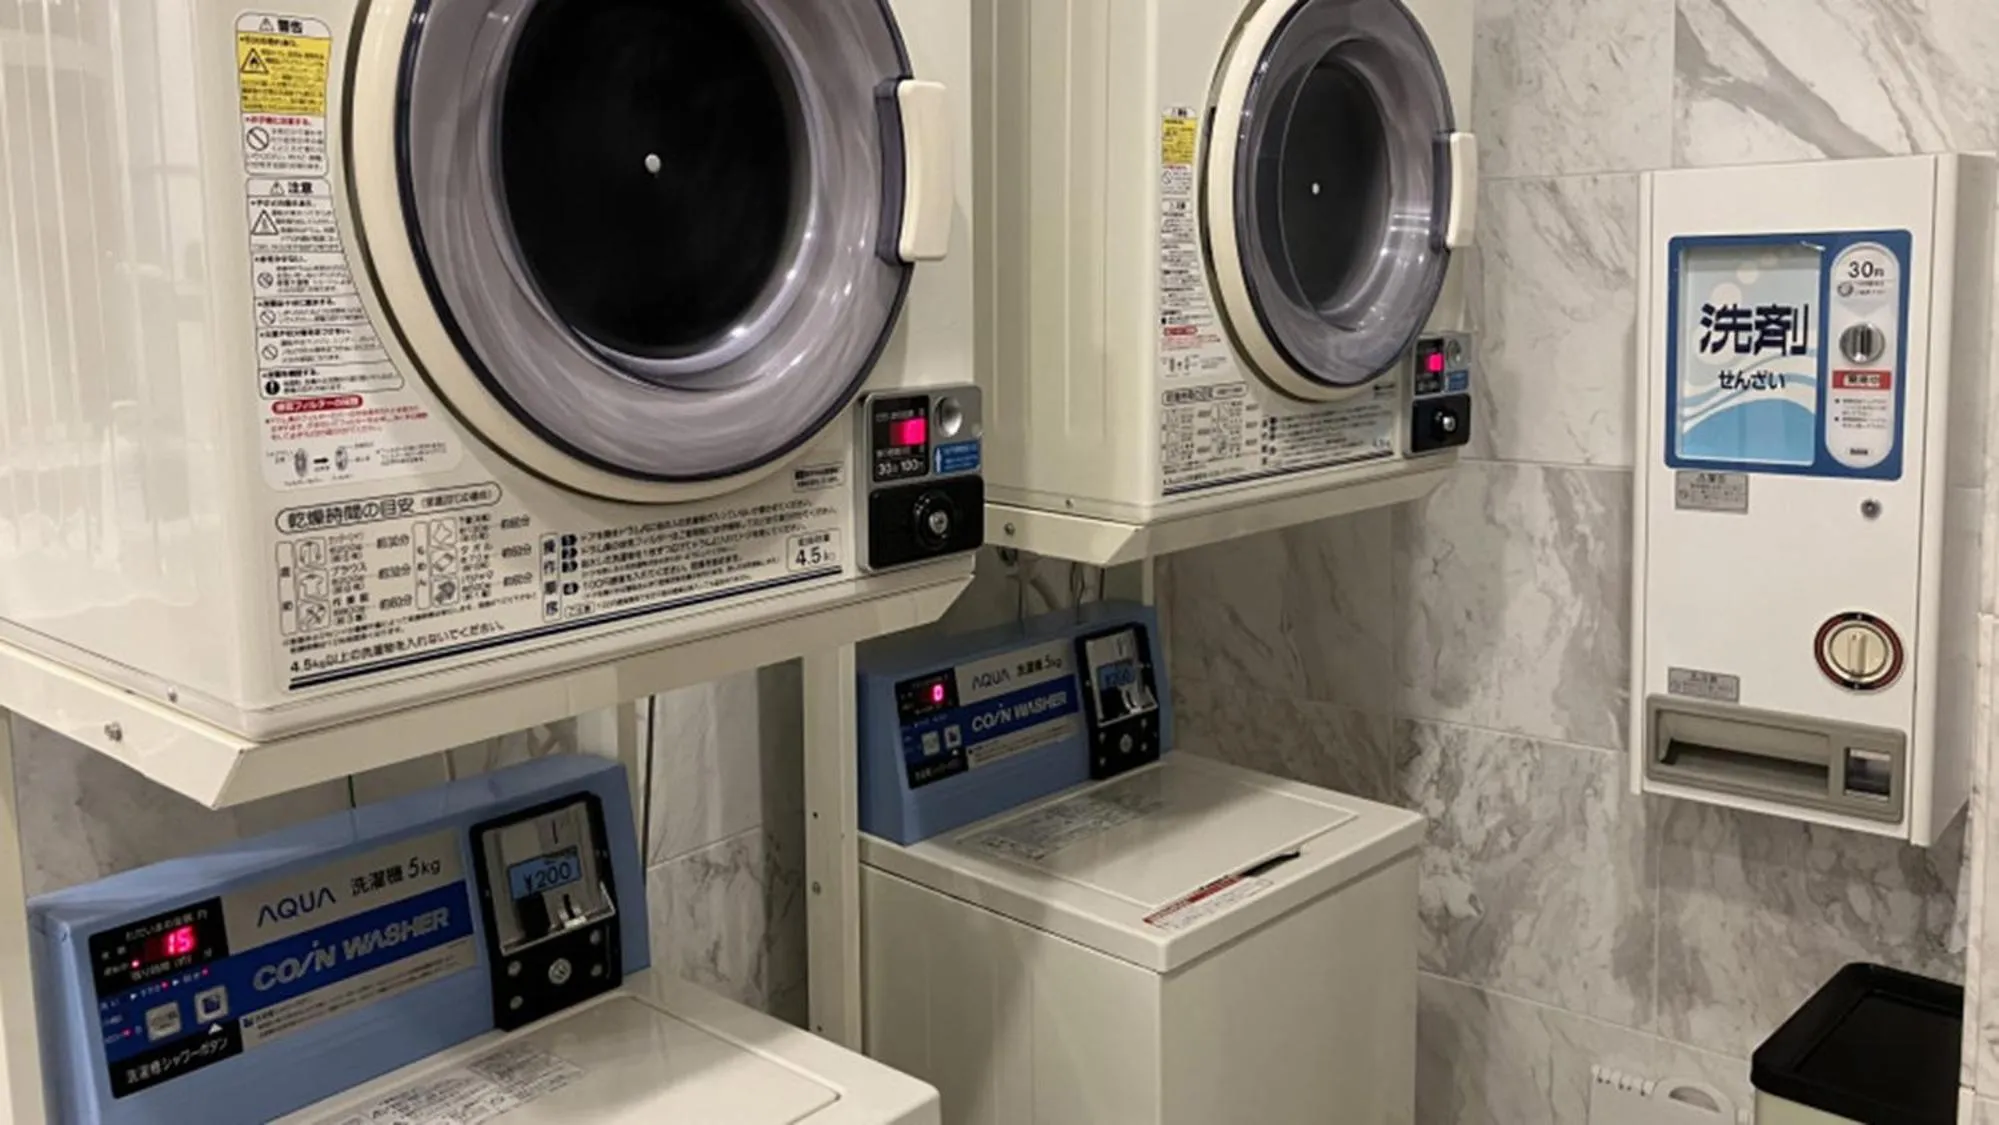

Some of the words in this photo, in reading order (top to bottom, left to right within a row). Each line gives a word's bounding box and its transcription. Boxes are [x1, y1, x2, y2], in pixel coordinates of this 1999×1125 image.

[1699, 303, 1810, 356] 洗剤
[1718, 370, 1786, 390] せんざい
[288, 498, 415, 529] 乾燥時間の目安
[933, 684, 943, 702] 0
[971, 668, 1012, 690] AQUA
[1014, 691, 1068, 719] WASHER
[523, 861, 573, 891] ¥200
[257, 886, 336, 928] AQUA
[350, 865, 403, 896] 洗濯機
[406, 856, 442, 879] 5kg
[164, 925, 195, 956] 15
[342, 907, 449, 960] WASHER
